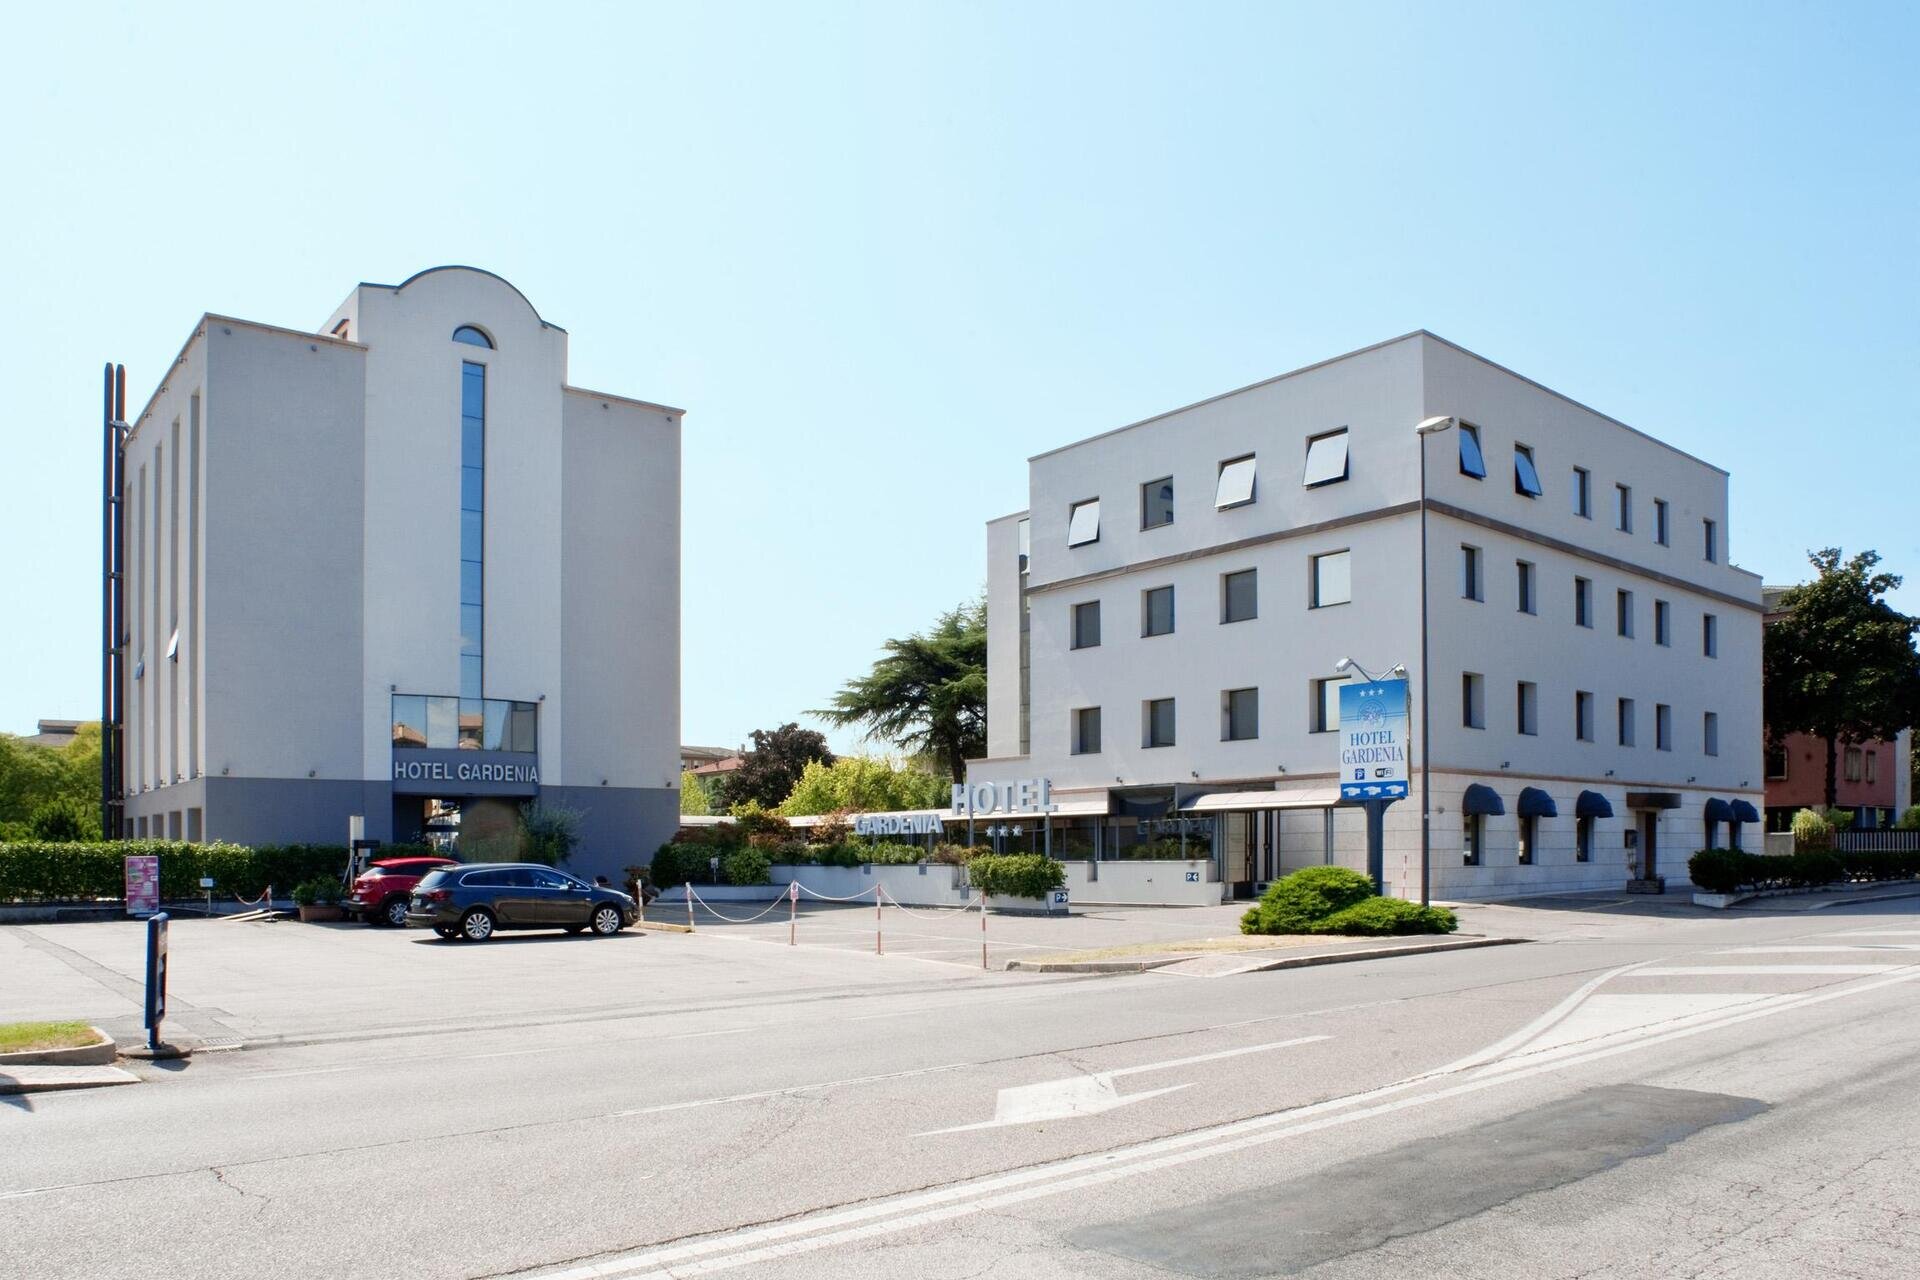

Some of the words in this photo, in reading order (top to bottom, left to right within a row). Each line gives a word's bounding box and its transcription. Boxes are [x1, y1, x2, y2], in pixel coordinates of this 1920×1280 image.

[1350, 731, 1395, 746] HOTEL
[1342, 746, 1404, 764] GARDENIA
[394, 761, 453, 779] HOTEL
[458, 763, 538, 782] GARDENIA
[952, 778, 1058, 816] HOTEL
[855, 814, 944, 835] GARDENIA
